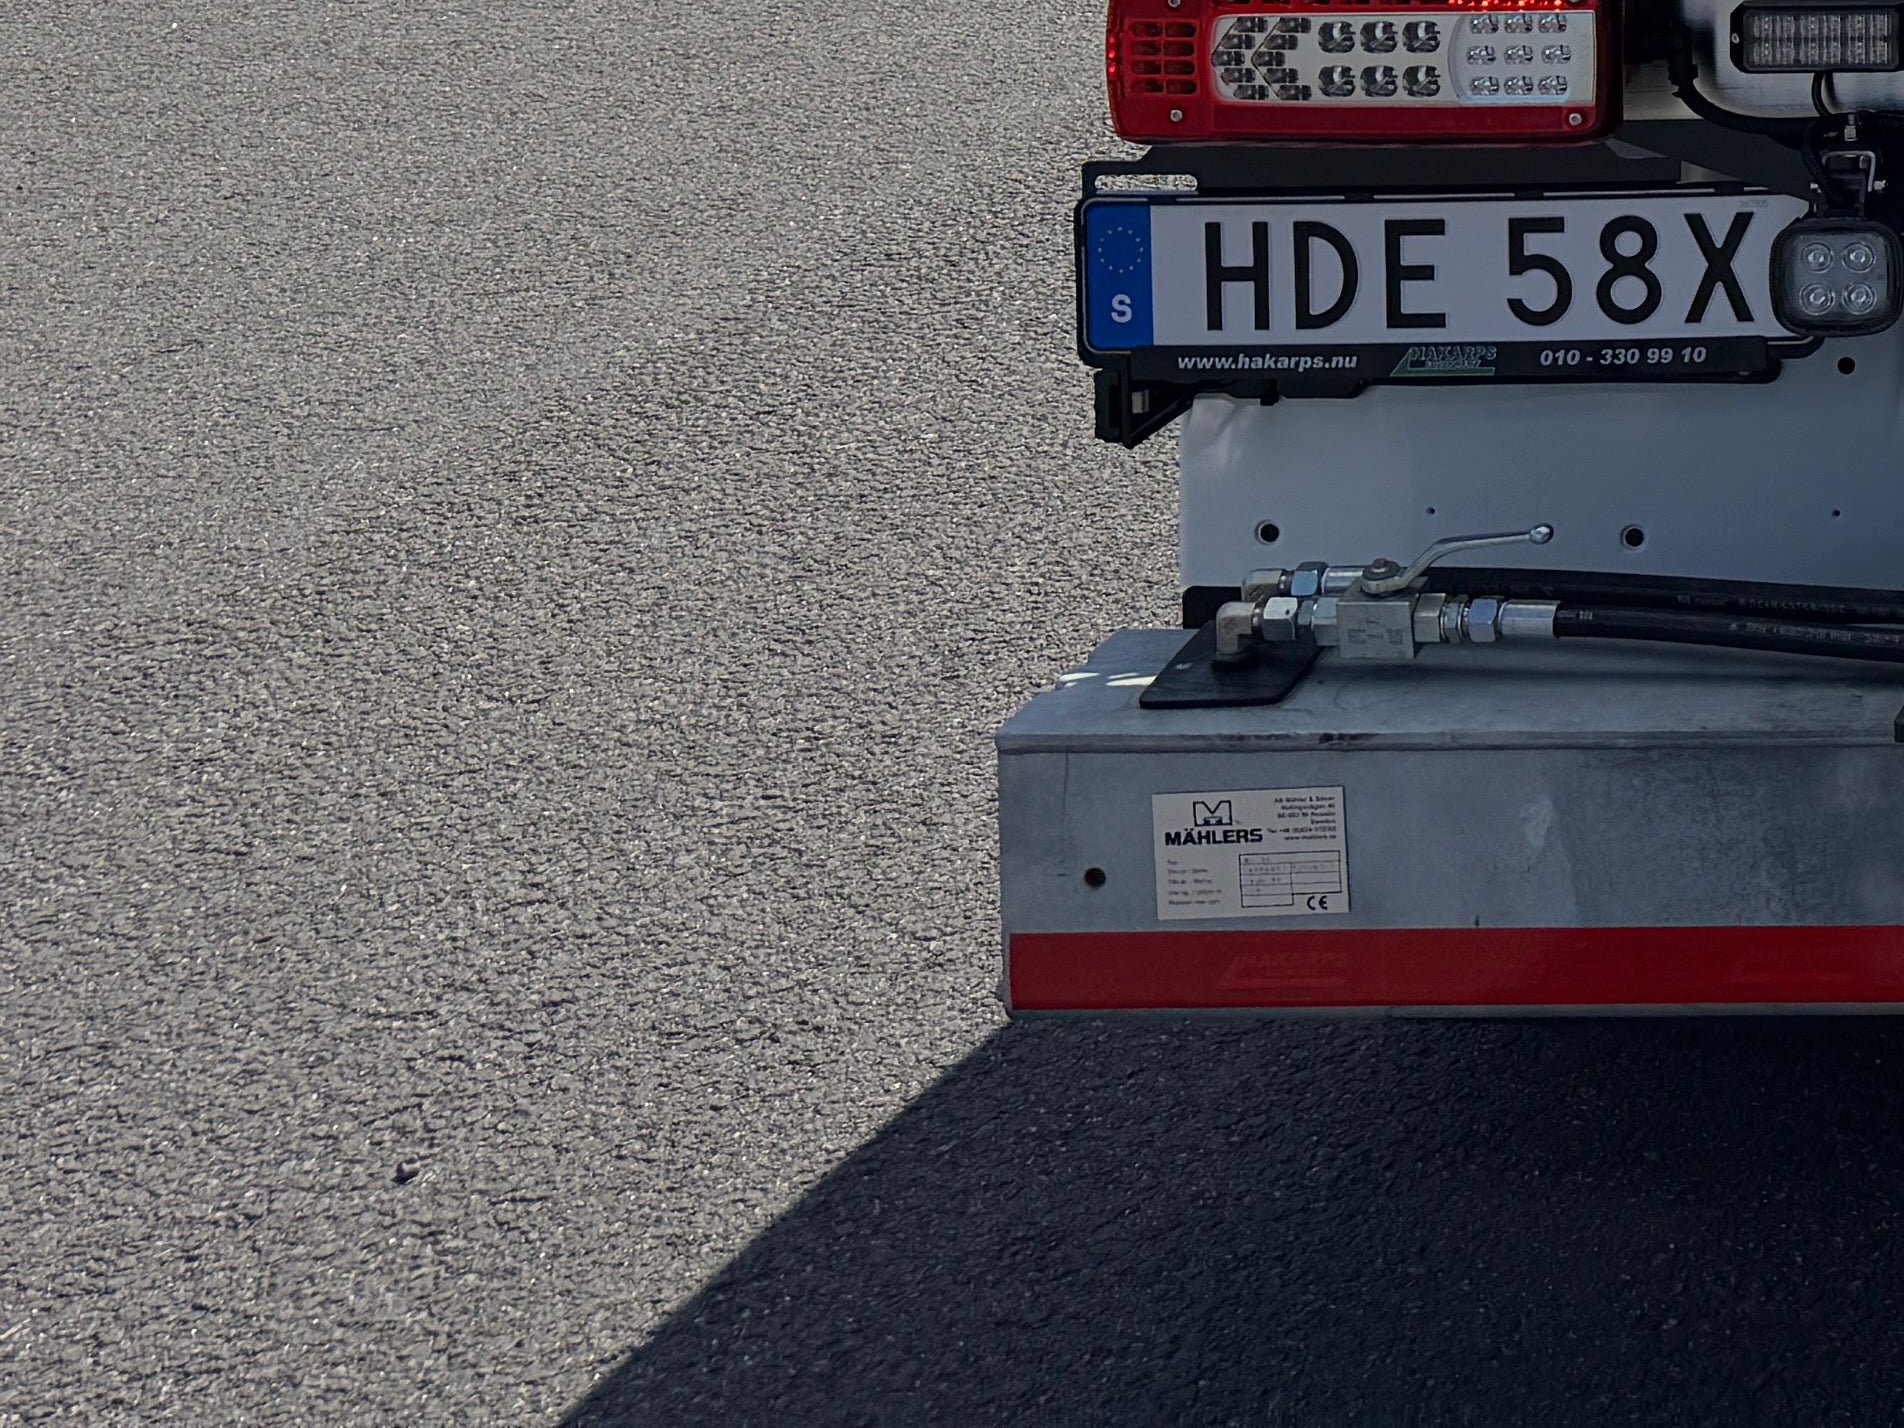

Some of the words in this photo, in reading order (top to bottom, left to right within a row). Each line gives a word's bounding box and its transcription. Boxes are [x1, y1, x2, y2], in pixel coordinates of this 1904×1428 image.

[1204, 217, 1447, 332] HDE
[1506, 211, 1755, 327] 58X
[1110, 292, 1132, 324] S
[1178, 352, 1357, 373] www.hakarps.nu
[1540, 348, 1581, 366] 010
[1599, 348, 1640, 365] 330
[1646, 347, 1674, 364] 99
[1681, 346, 1708, 363] 10
[1164, 827, 1263, 846] MÄHLERS
